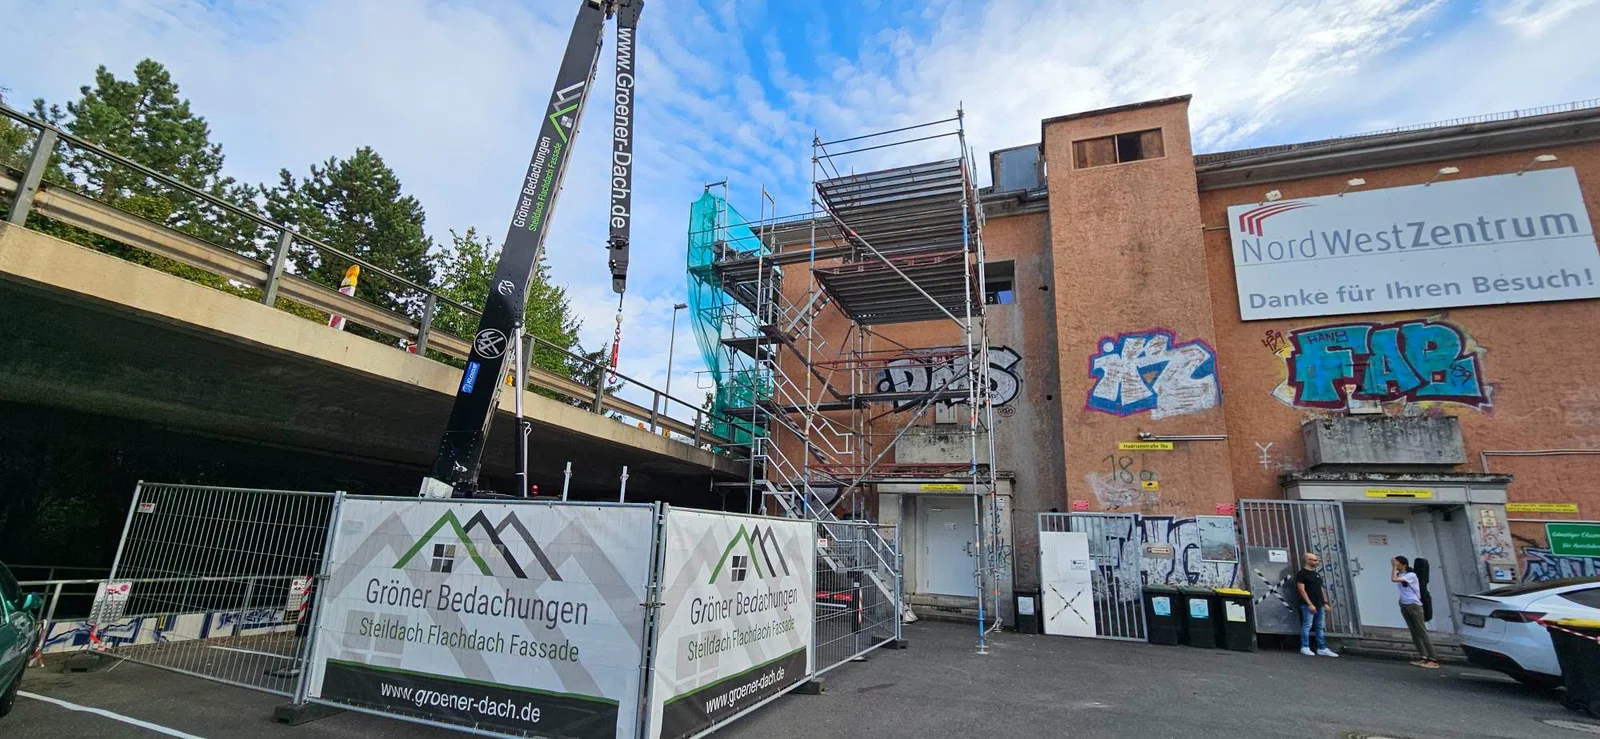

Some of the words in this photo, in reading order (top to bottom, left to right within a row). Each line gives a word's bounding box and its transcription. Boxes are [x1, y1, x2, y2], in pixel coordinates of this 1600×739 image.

[612, 27, 634, 229] www.Groener-Dach.de
[513, 196, 532, 228] Gröner
[523, 136, 551, 196] Bedachungen
[528, 202, 545, 232] Steildach
[538, 167, 555, 201] Flachdach
[548, 142, 563, 169] Fassade
[1249, 288, 1329, 309] Danke
[1336, 285, 1376, 303] für
[1386, 279, 1462, 300] Ihren
[1472, 268, 1594, 294] Besuch!
[365, 578, 432, 609] Gröner
[436, 584, 588, 630] Bedachungen
[690, 596, 732, 625] Gröner
[736, 588, 798, 617] Bedachungen
[359, 616, 424, 643] Steildach
[427, 624, 505, 653] Flachdach
[509, 634, 579, 662] Fassade
[687, 633, 732, 662] Steildach
[732, 624, 772, 650] Flachdach
[772, 616, 795, 638] Fassade
[380, 682, 541, 723] www.groener-dach.de
[705, 666, 785, 714] www.groener-dach.de
